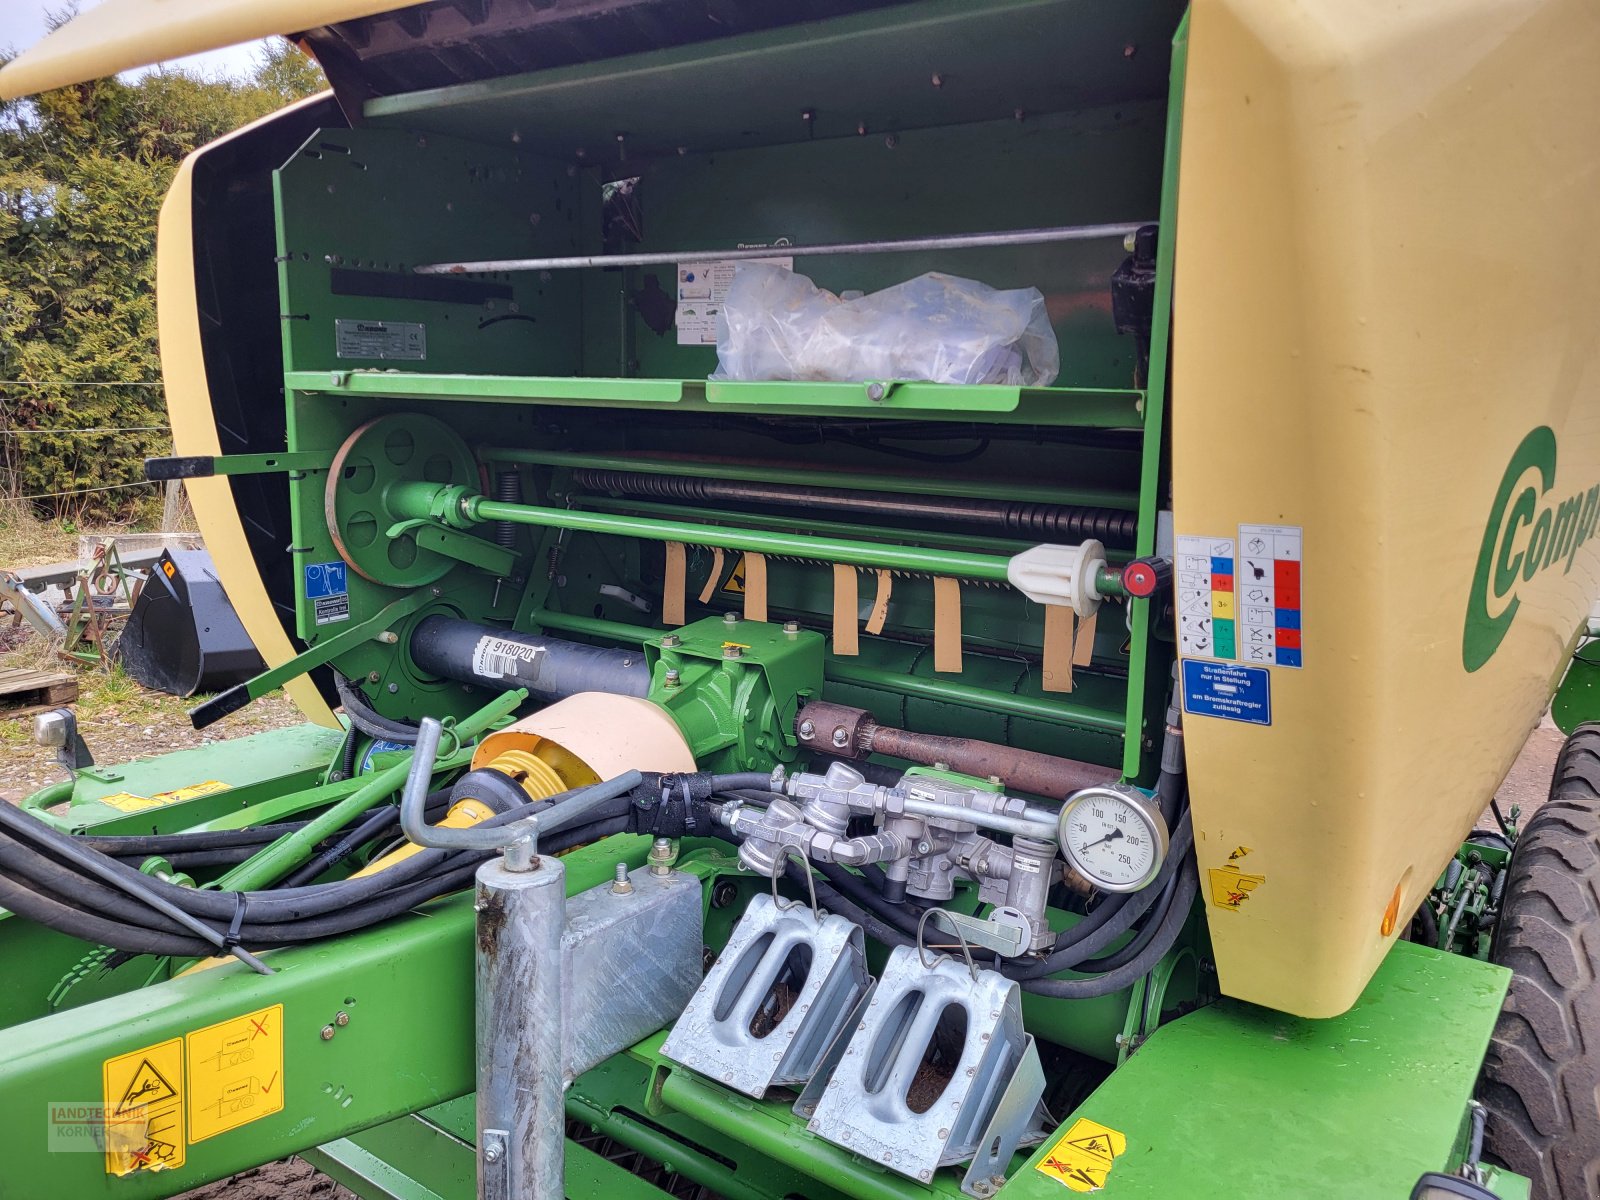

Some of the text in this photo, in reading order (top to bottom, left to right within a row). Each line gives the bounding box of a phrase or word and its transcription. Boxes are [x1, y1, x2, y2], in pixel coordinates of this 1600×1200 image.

[493, 641, 533, 660] 918020
[1203, 666, 1247, 678] Straßenfahrt
[1221, 676, 1251, 686] Stellung
[1204, 695, 1262, 709] Bremskraftregler
[1212, 704, 1242, 714] zulässig
[1092, 808, 1104, 819] 100
[1114, 813, 1127, 824] 150
[1079, 823, 1088, 833] 50
[1126, 835, 1140, 846] 200
[1118, 853, 1131, 865] 250
